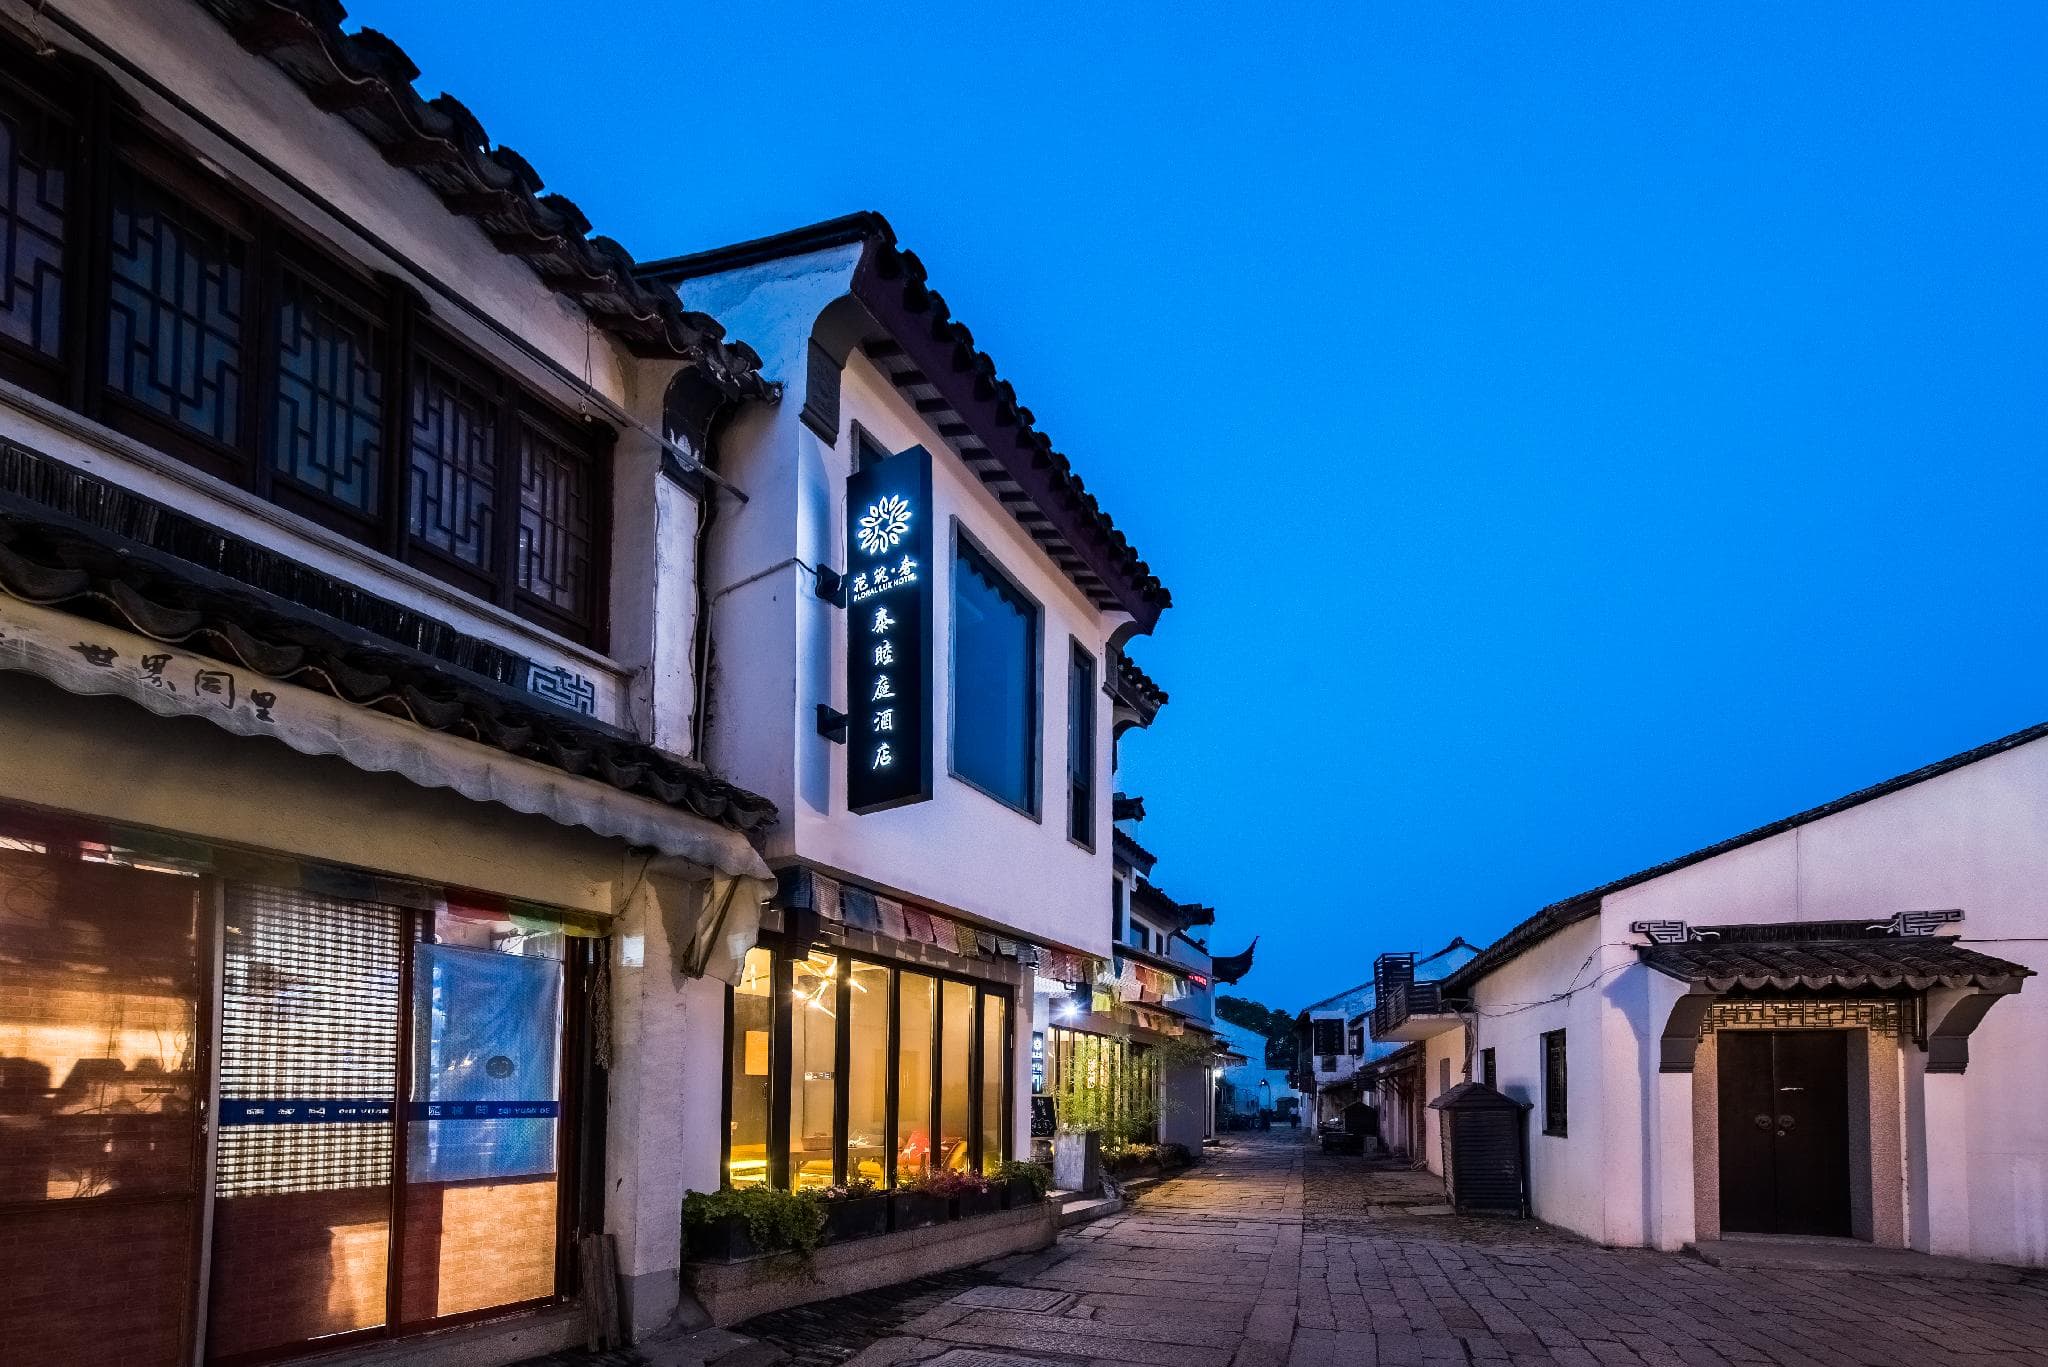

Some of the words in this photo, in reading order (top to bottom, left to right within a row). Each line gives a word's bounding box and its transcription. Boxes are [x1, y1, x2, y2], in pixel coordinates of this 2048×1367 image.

[853, 587, 879, 602] FLORAL
[879, 581, 893, 592] LUX
[893, 572, 917, 587] HOTEL
